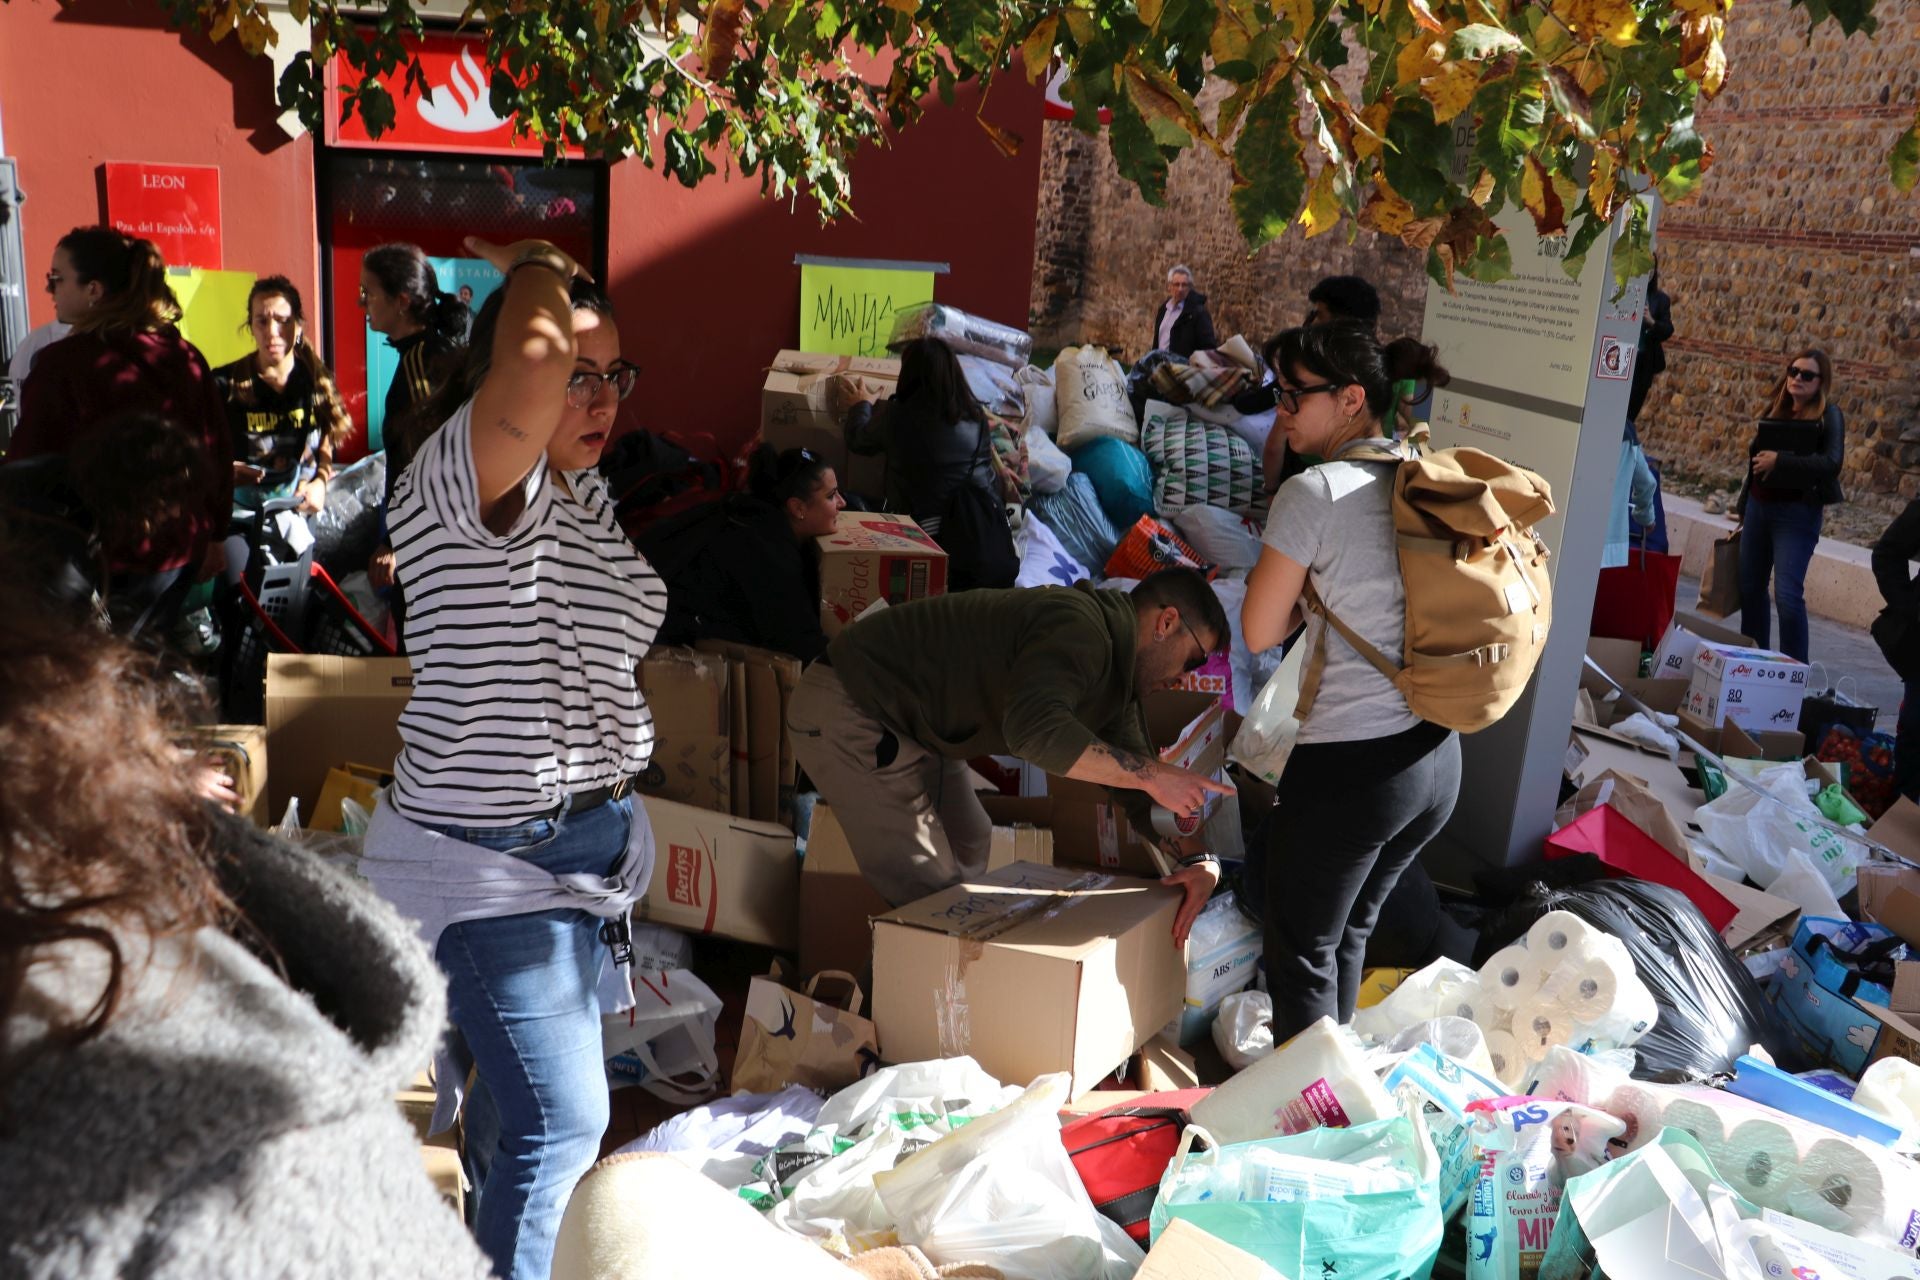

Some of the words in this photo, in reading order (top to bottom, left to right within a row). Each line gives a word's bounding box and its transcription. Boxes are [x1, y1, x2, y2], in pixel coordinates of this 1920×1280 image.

[143, 174, 186, 189] LEON
[116, 220, 135, 232] Pza.
[138, 221, 153, 232] del
[1667, 654, 1682, 666] 80
[1791, 671, 1804, 681] 80
[1728, 688, 1742, 699] 80
[674, 848, 691, 903] Berlys
[1233, 952, 1255, 968] Pants
[1311, 1087, 1328, 1112] cocina
[1318, 1082, 1334, 1106] Papel
[1331, 1106, 1339, 1116] de
[1305, 1091, 1328, 1127] compacto
[1484, 1180, 1494, 1215] ADULTO
